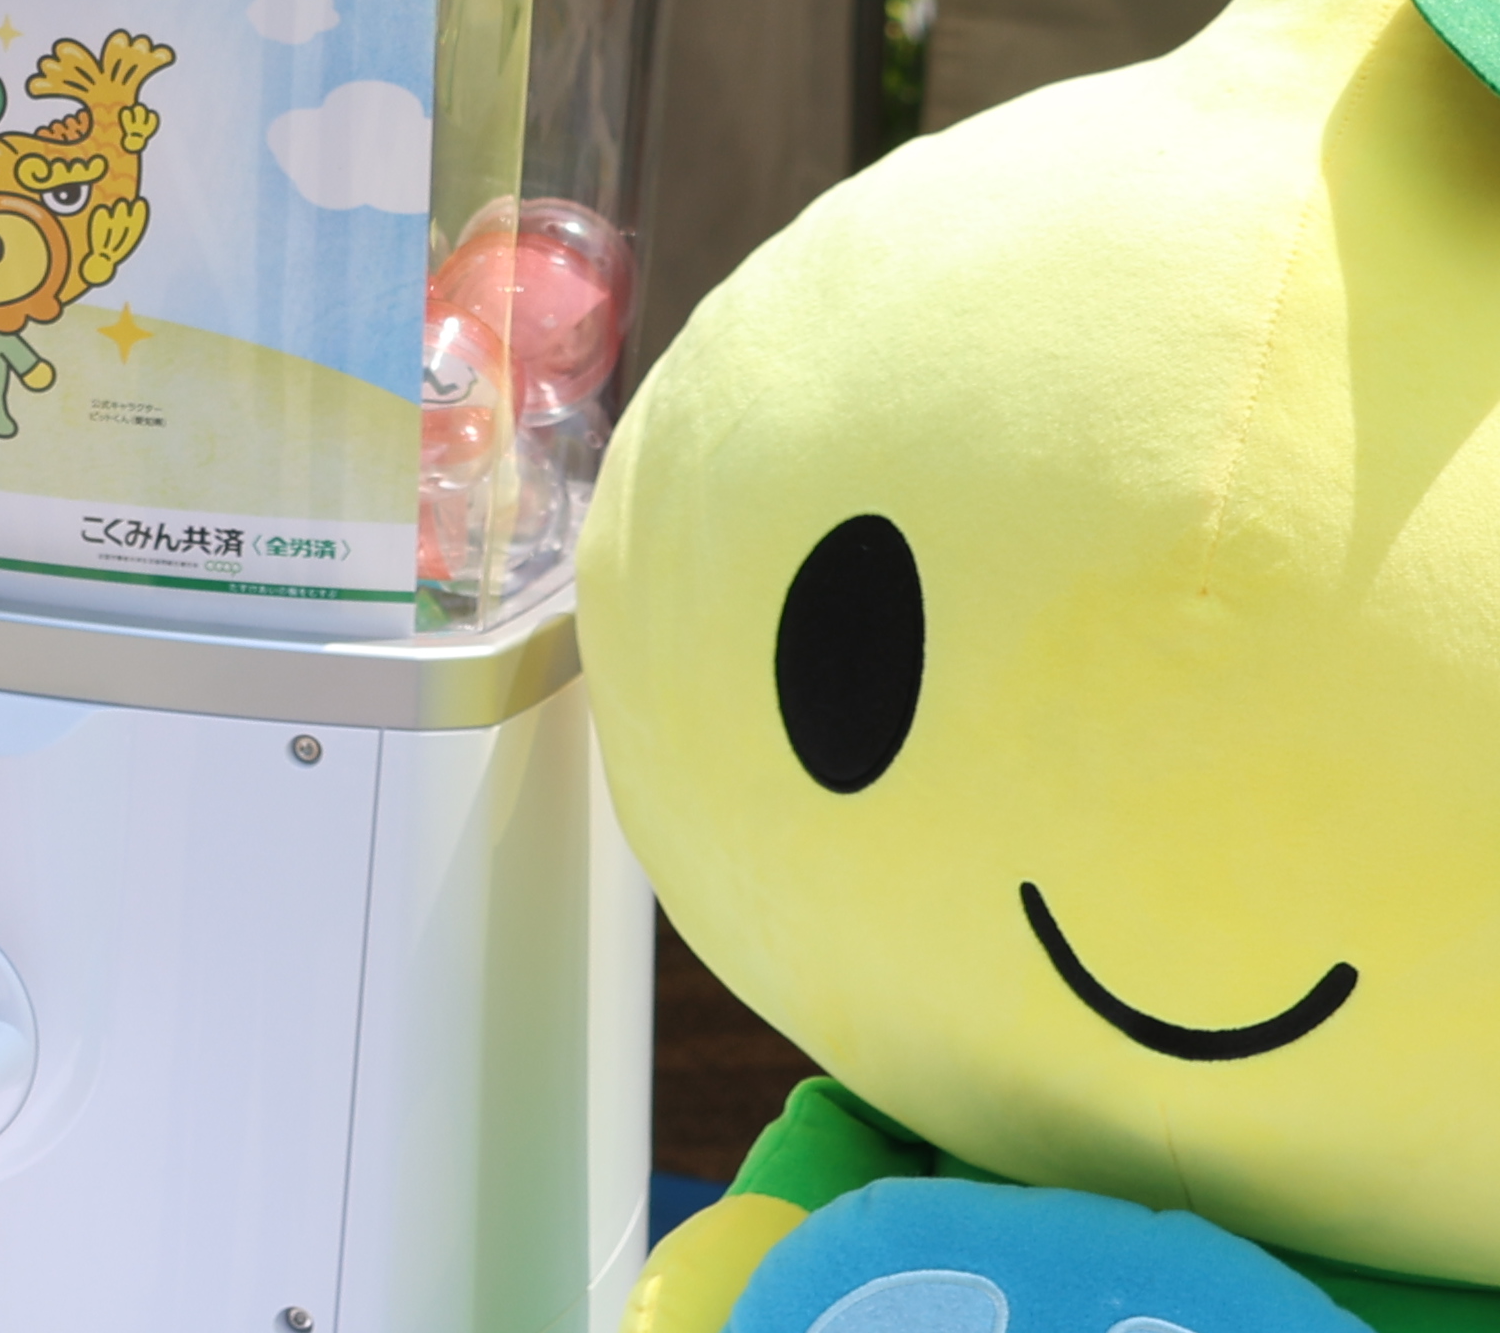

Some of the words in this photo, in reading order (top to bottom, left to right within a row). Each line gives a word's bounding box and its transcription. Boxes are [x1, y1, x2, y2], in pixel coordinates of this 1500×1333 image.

[90, 398, 162, 414] 公式キャラクター
[80, 515, 245, 558] こくみん共済
[203, 559, 243, 577] coop
